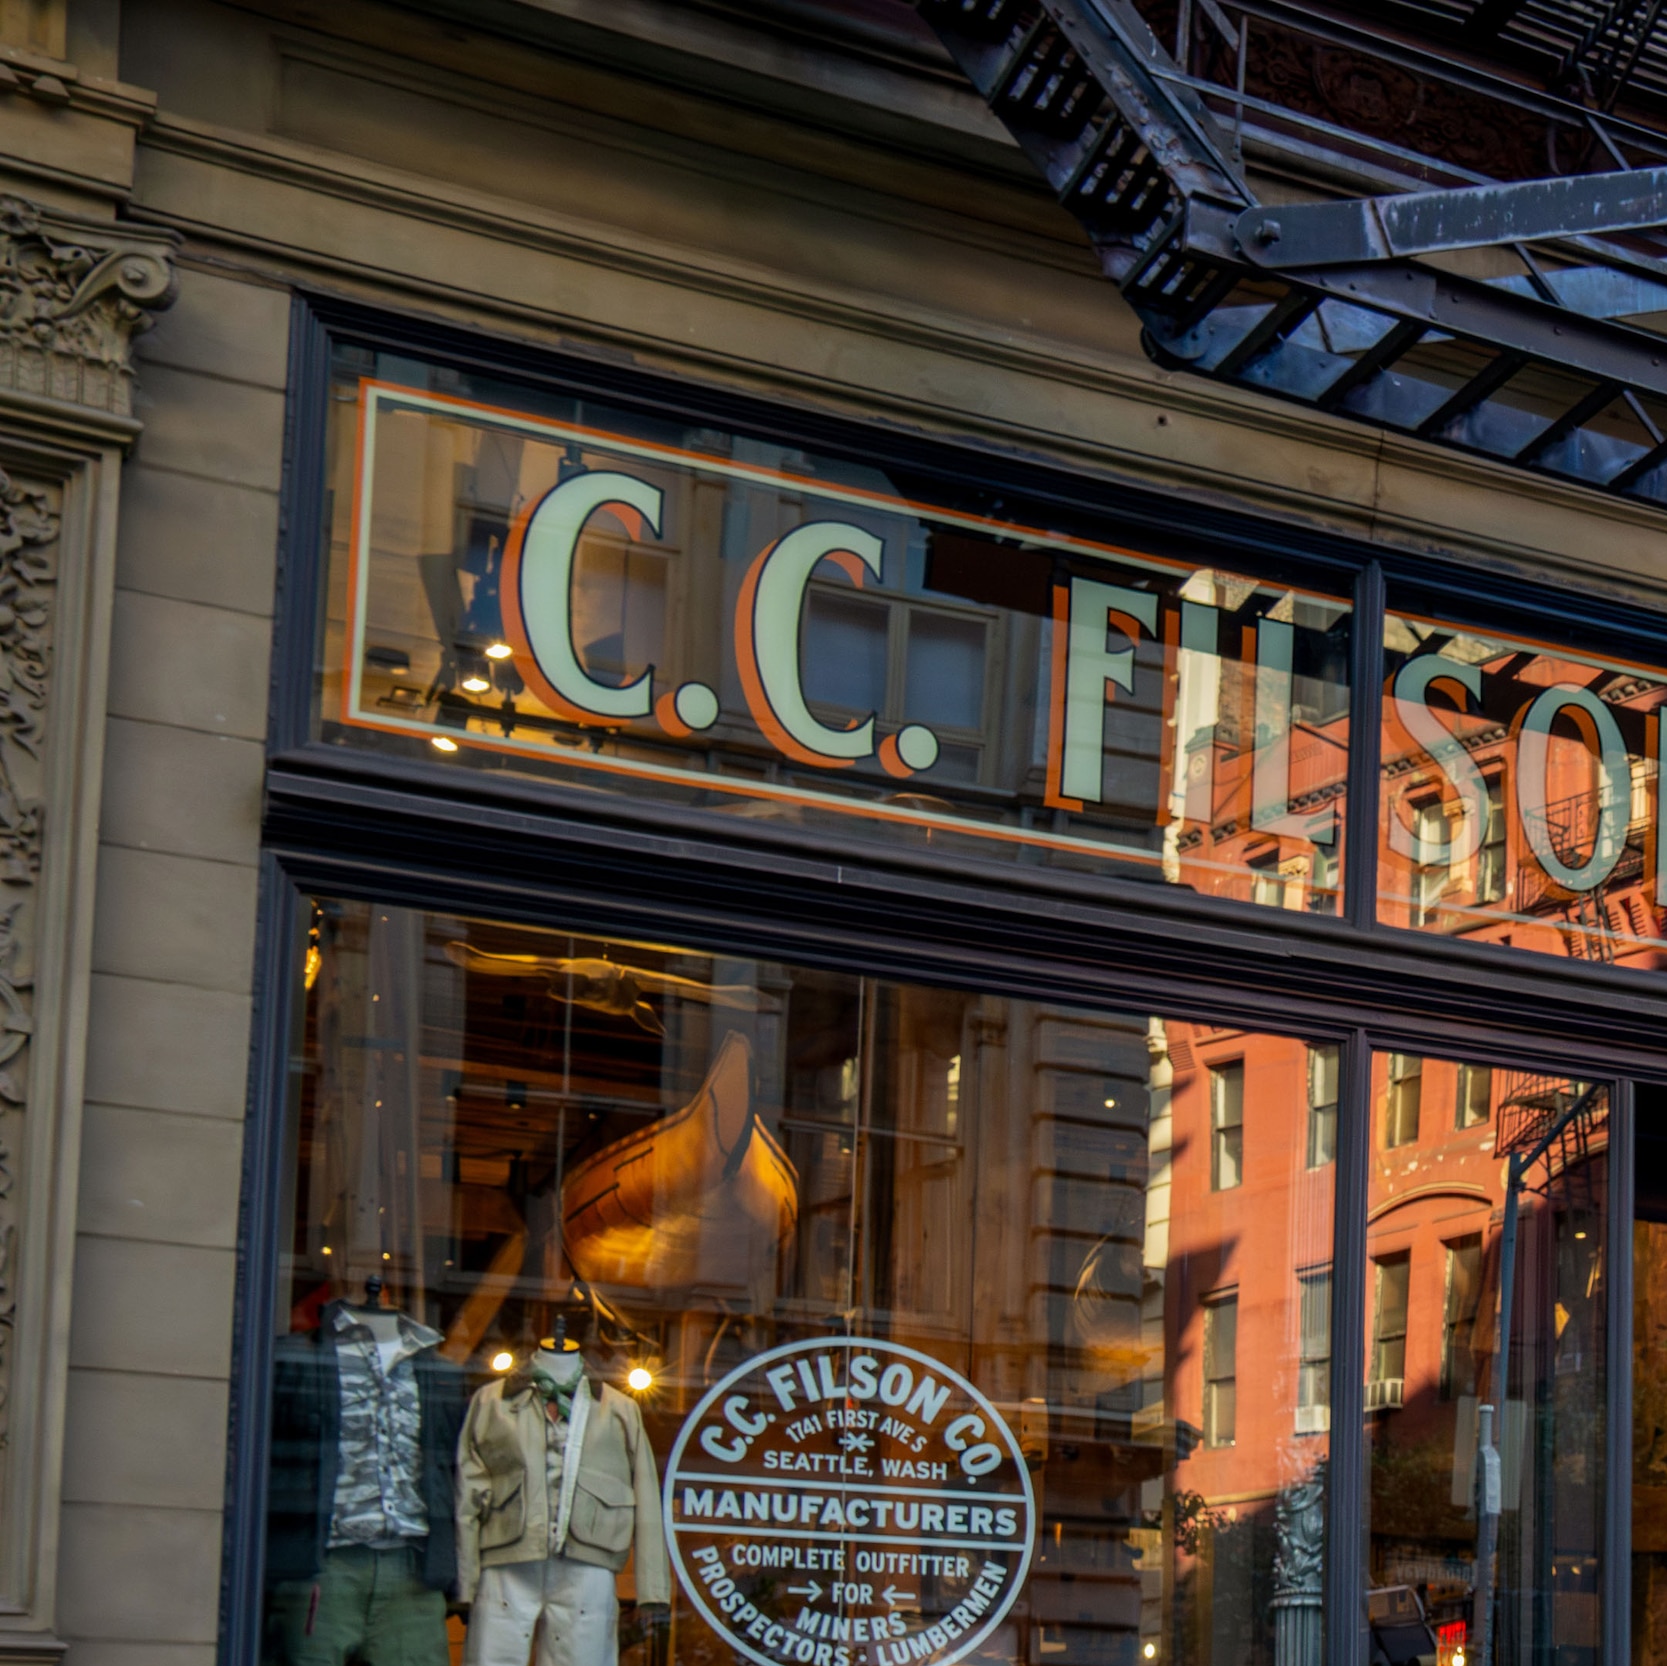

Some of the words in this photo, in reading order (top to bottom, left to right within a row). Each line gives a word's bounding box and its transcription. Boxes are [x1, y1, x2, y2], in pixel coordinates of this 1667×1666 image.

[766, 1355, 951, 1425] FILSON
[944, 1414, 1003, 1484] CO.
[785, 1414, 823, 1444] 1741
[826, 1409, 878, 1431] FIRST
[879, 1416, 909, 1444] AVE
[910, 1435, 928, 1453] S
[763, 1450, 874, 1477] SEATTLE,
[881, 1458, 948, 1481] WASH
[683, 1487, 1018, 1537] MANUFACTURERS
[731, 1543, 846, 1571] COMPLETE
[855, 1551, 970, 1579] OUTFITTER
[831, 1582, 873, 1605] FOR
[796, 1606, 907, 1643] MINERS
